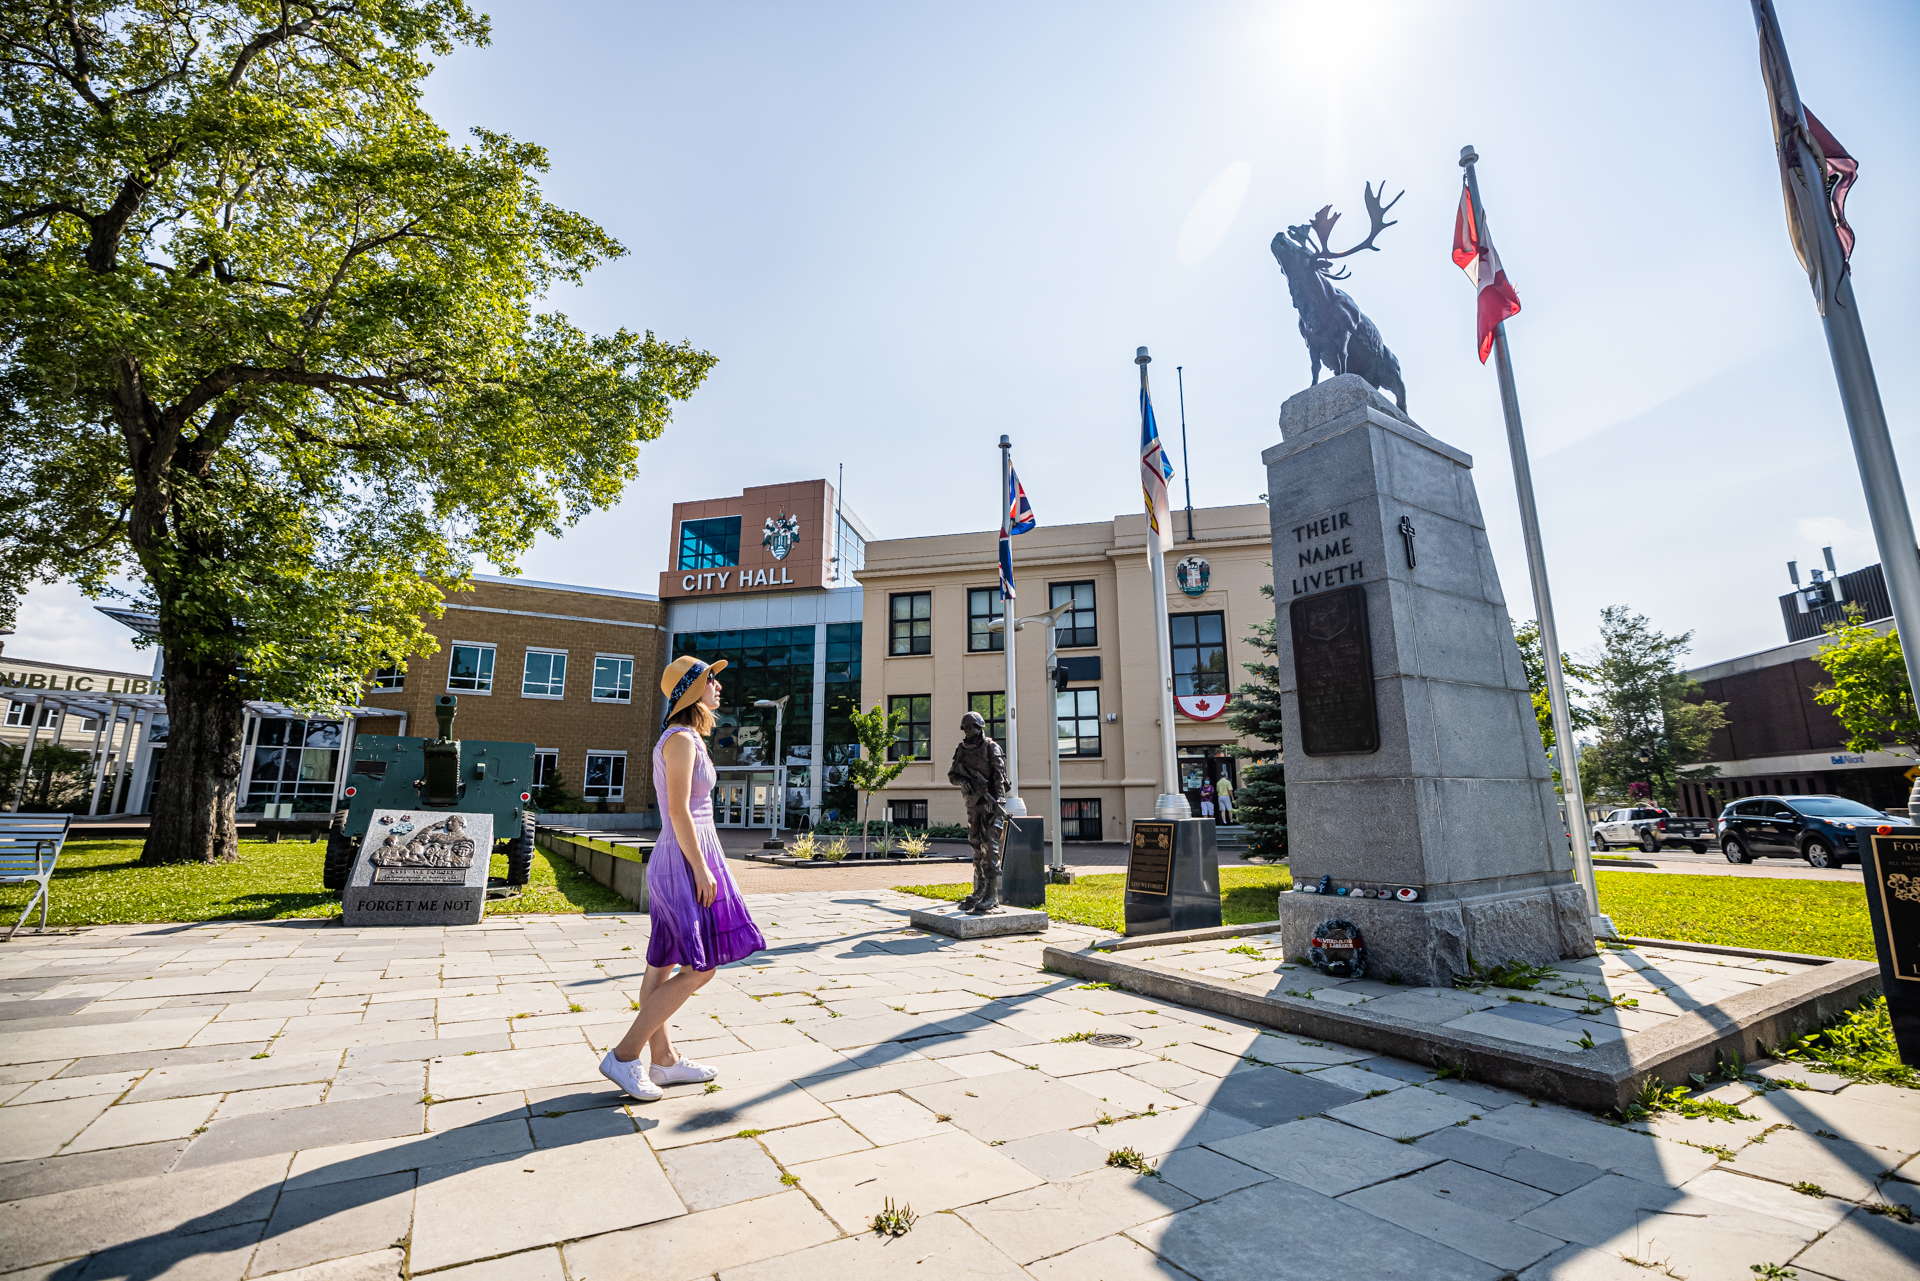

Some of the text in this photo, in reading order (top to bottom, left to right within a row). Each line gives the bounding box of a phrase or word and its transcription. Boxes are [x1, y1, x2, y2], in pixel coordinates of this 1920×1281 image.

[1291, 512, 1352, 543] THEIR
[1298, 536, 1353, 568] NAME
[682, 567, 794, 591] CITY HALL
[1292, 560, 1363, 596] LIVETH
[0, 672, 95, 692] UBLIC
[357, 900, 473, 912] FORGET ME NOT
